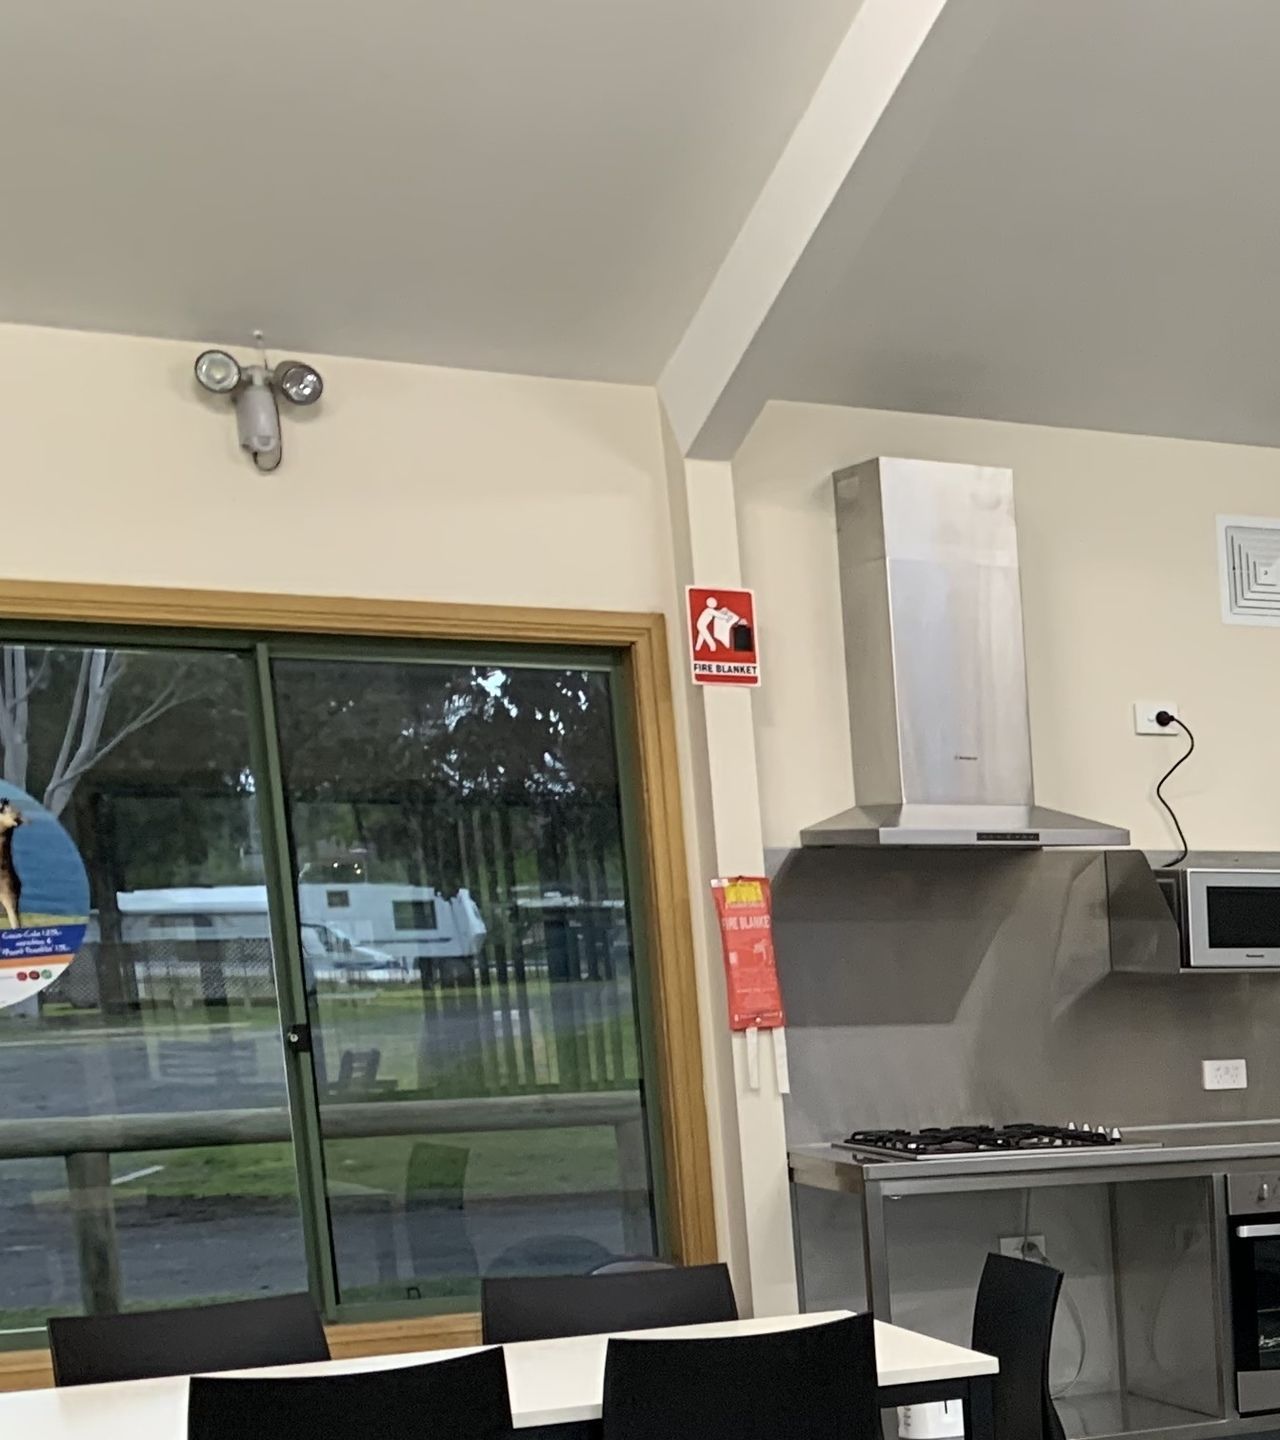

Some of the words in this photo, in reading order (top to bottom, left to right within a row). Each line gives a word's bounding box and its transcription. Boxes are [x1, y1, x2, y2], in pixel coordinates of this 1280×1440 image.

[694, 663, 713, 673] FIRE
[715, 664, 757, 674] BLANKET
[739, 915, 770, 930] BLANKE
